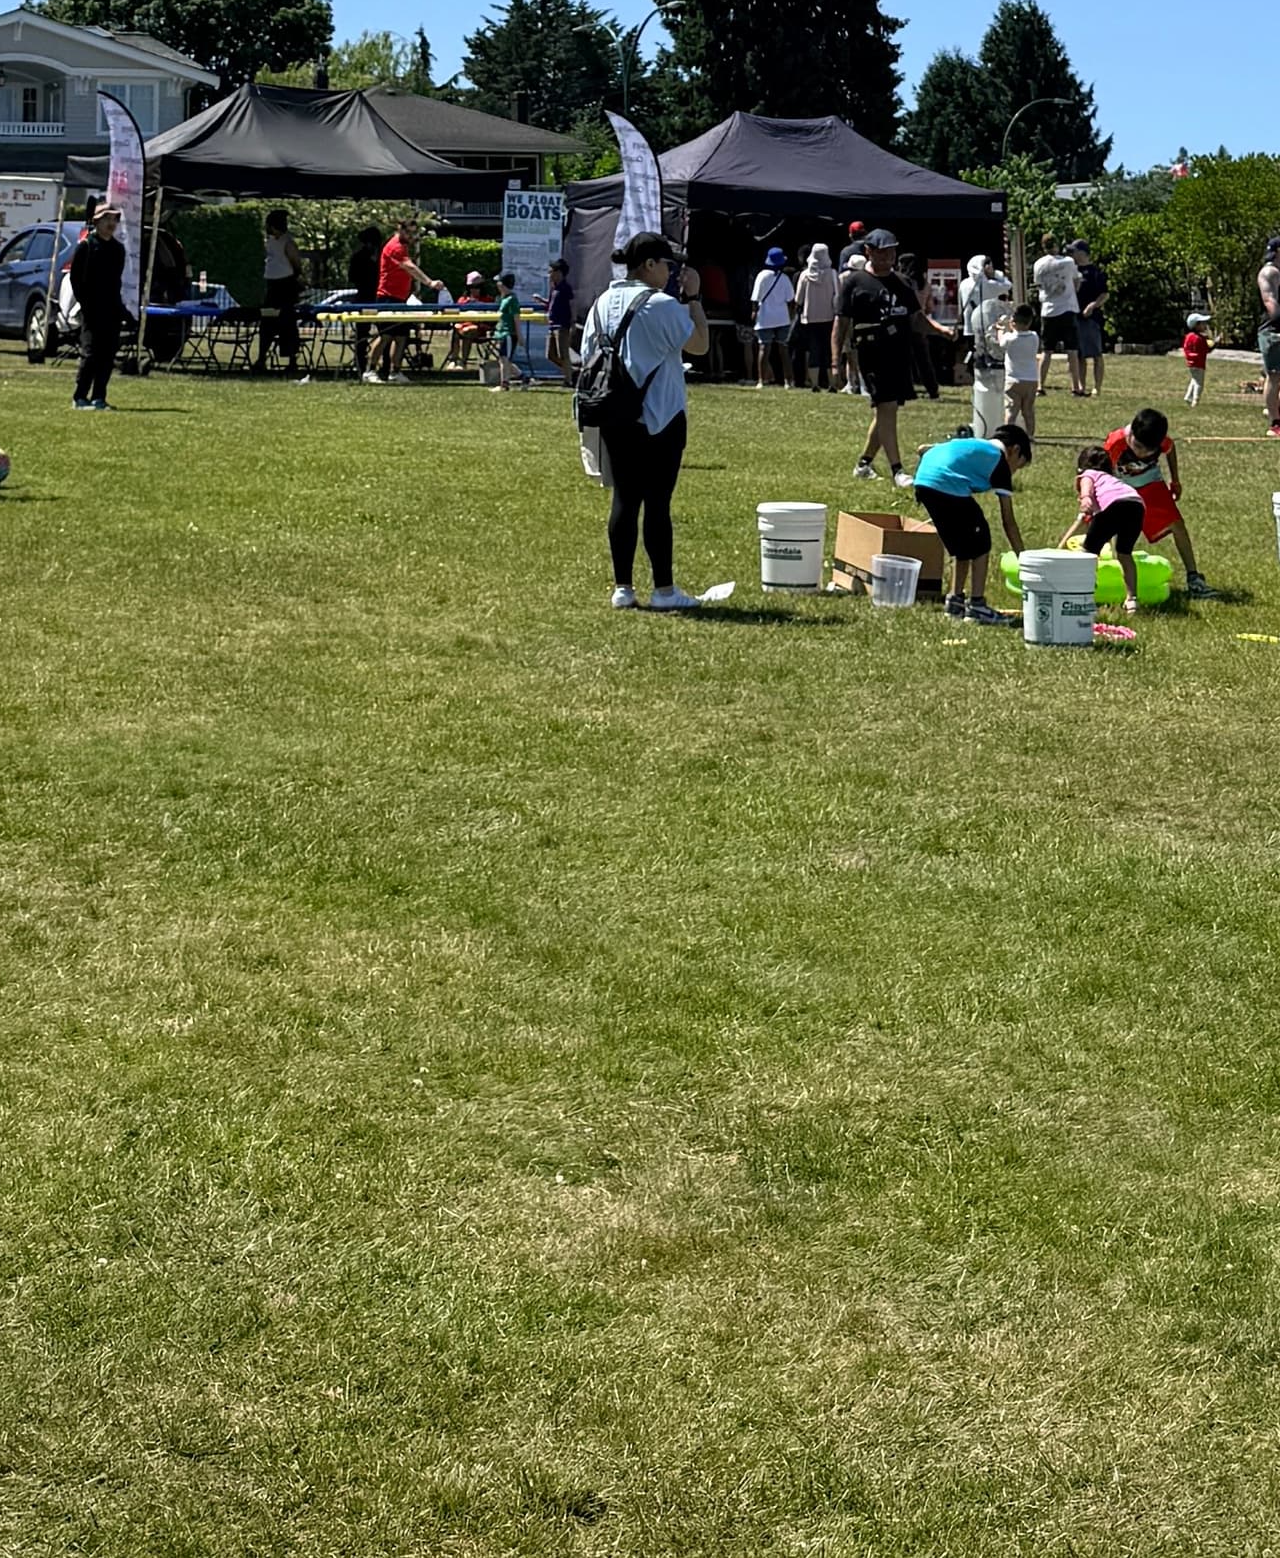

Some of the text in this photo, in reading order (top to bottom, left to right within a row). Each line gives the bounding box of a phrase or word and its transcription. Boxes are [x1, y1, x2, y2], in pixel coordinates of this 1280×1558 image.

[12, 189, 46, 201] Fun!
[506, 194, 562, 205] WE FLOAT
[506, 204, 561, 221] BOATS
